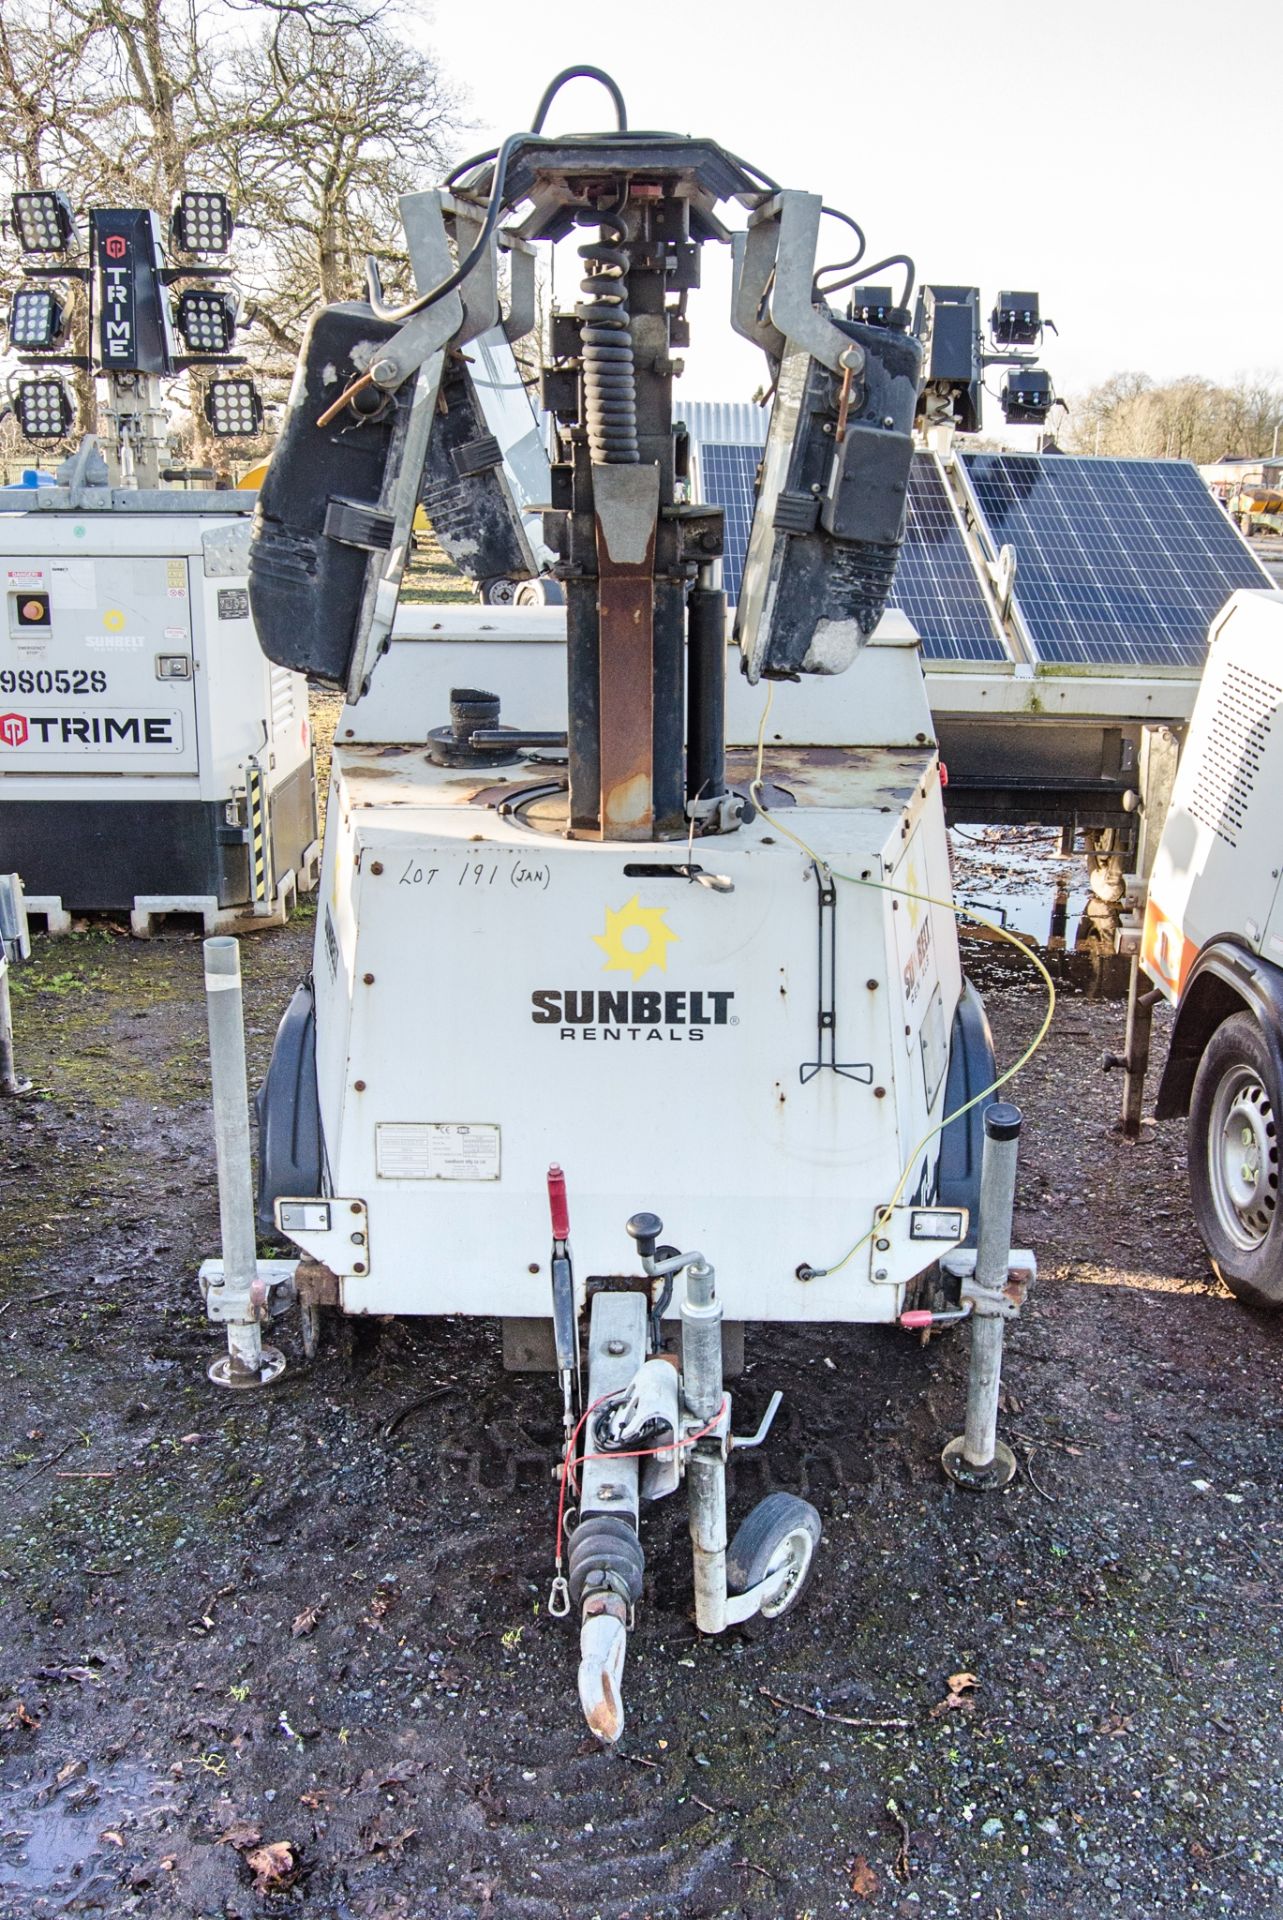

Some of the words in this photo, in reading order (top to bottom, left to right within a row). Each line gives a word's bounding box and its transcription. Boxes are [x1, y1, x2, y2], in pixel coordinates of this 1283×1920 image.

[106, 267, 131, 357] TRIME
[85, 635, 145, 647] SUNBELT
[0, 669, 107, 694] 980528
[30, 717, 172, 744] TRIME
[398, 859, 439, 886] LOT
[458, 863, 498, 886] 191
[510, 861, 551, 889] (JAN)
[560, 1028, 704, 1041] RENTALS
